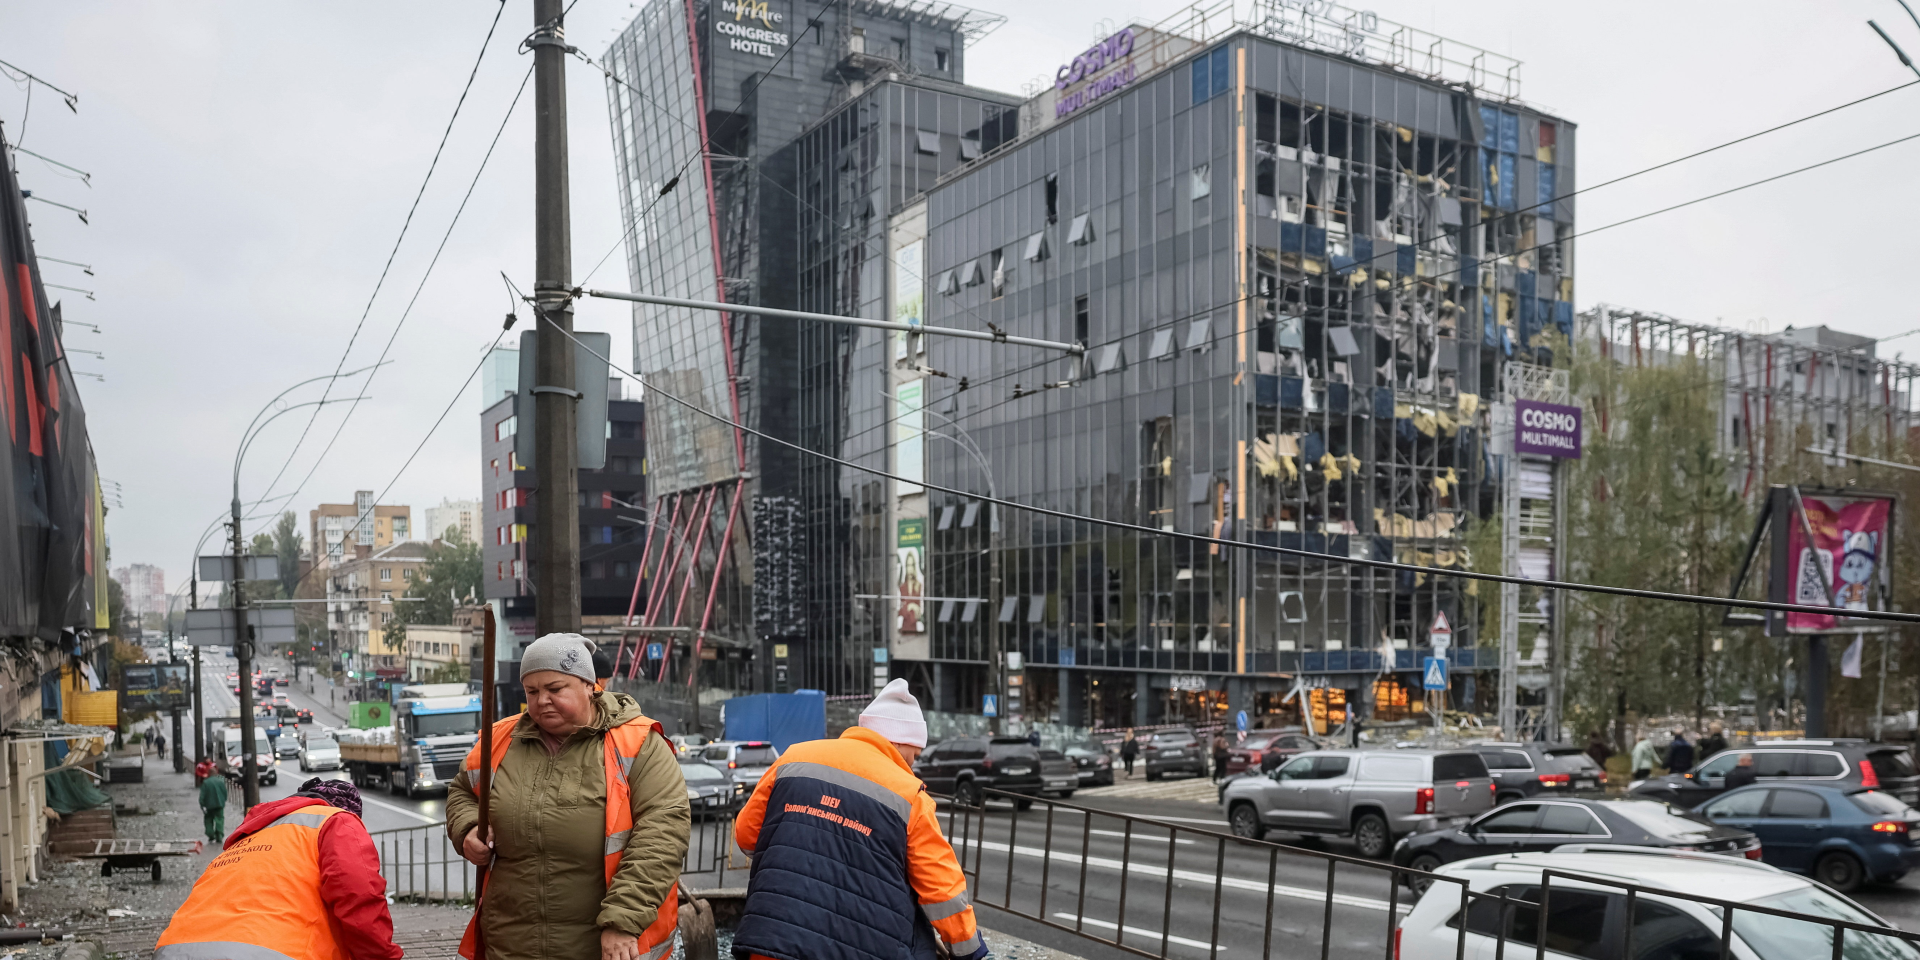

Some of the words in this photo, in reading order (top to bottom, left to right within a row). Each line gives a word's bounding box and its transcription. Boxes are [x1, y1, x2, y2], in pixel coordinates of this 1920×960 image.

[716, 21, 788, 46] CONGRESS
[730, 37, 775, 57] HOTEL
[1056, 27, 1134, 89] COSMO
[1522, 408, 1576, 432] COSMO
[1521, 430, 1575, 449] MULTIMALL
[820, 794, 841, 809] ШЕУ
[842, 818, 873, 837] району
